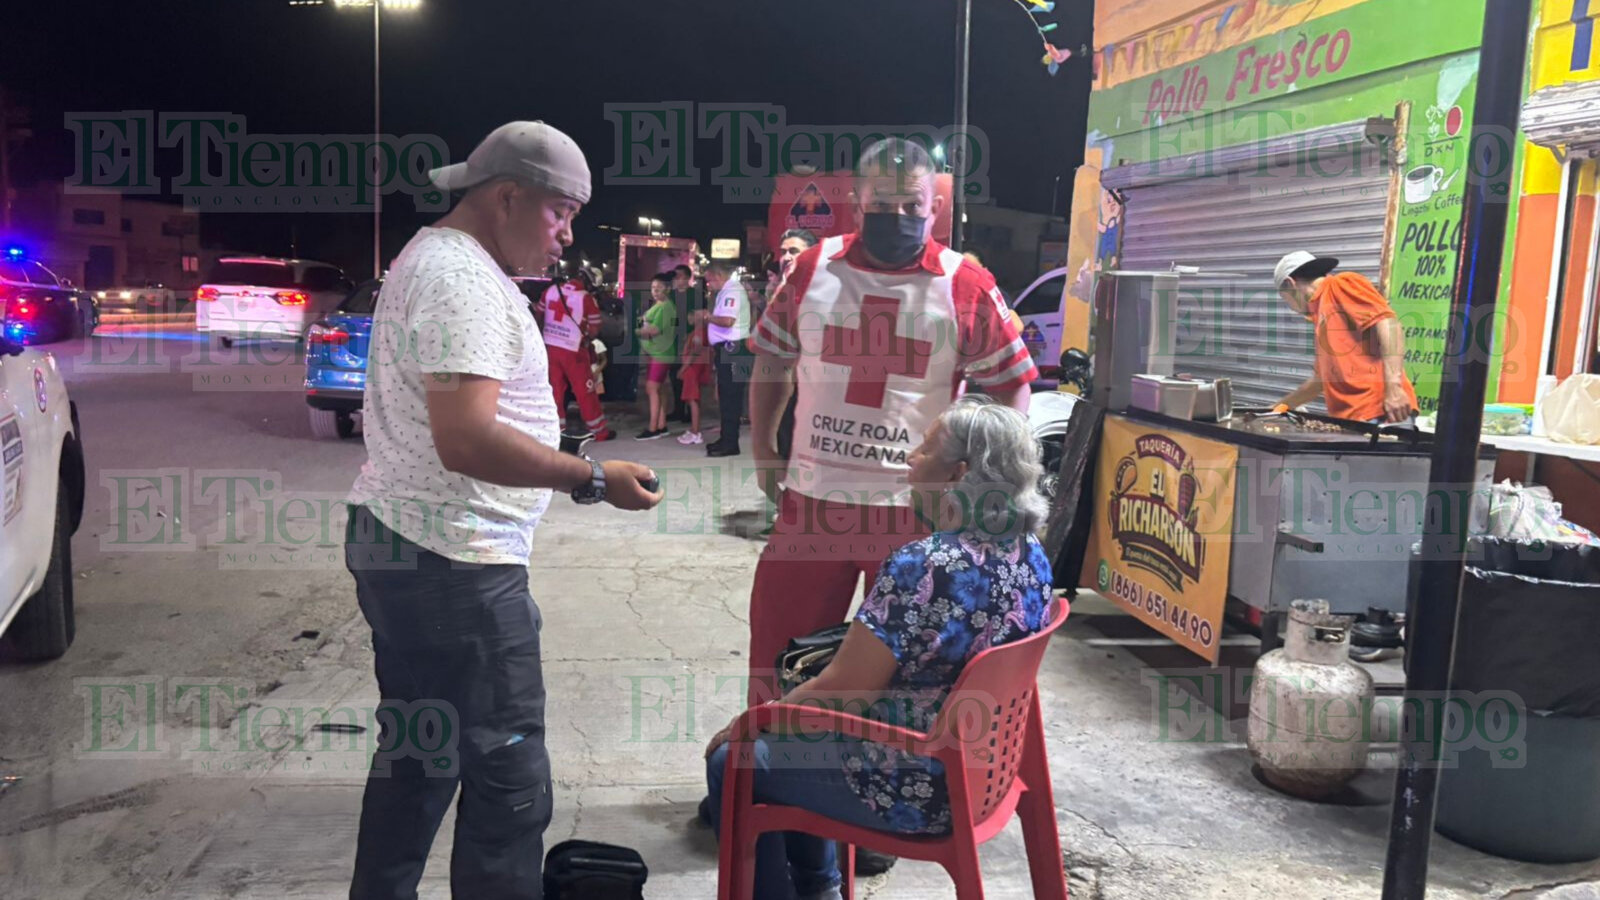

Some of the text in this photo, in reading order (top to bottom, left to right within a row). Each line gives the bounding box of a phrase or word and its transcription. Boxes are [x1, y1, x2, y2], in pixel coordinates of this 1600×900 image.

[1141, 29, 1351, 126] Pollo Fresco
[1425, 144, 1454, 157] DXN
[1414, 254, 1447, 278] 100%
[1398, 281, 1453, 299] MEXICA
[812, 414, 910, 444] CRUZ ROJA
[810, 434, 906, 463] MEXICANA
[1151, 467, 1165, 497] EL
[1119, 497, 1196, 567] RICHARSON
[1111, 571, 1212, 646] (866) 651 44 90
